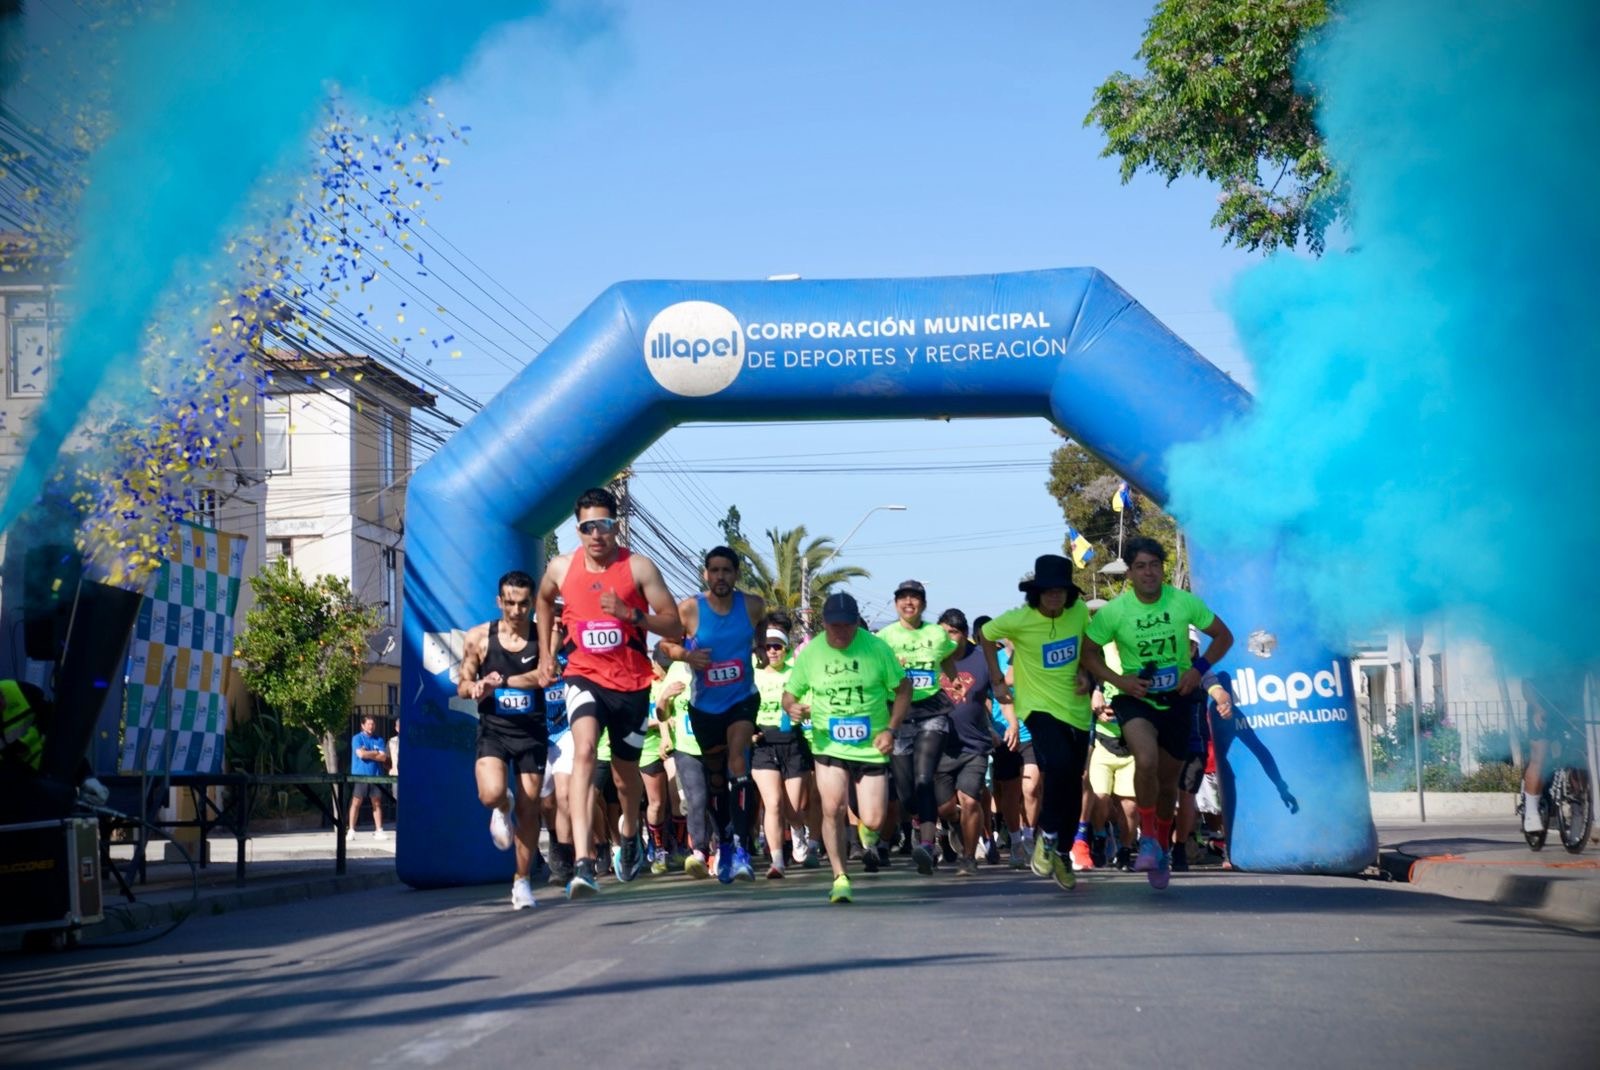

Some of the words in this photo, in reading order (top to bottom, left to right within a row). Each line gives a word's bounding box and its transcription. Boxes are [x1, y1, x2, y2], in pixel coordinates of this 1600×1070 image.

[746, 316, 916, 340] CORPORACIÓN
[924, 311, 1050, 335] MUNICIPAL
[651, 330, 738, 364] illapel
[748, 351, 776, 368] DE
[784, 348, 896, 368] DEPORTES
[905, 347, 918, 364] Y
[926, 336, 1067, 364] RECREACIÓN
[587, 630, 618, 646] 100
[1137, 634, 1177, 657] 271
[1050, 646, 1074, 663] 015
[713, 667, 737, 681] 113
[912, 677, 930, 689] 27
[503, 696, 528, 709] 014
[825, 685, 865, 706] 271
[1234, 708, 1348, 731] MUNICIPALIDAD
[837, 726, 865, 739] 016
